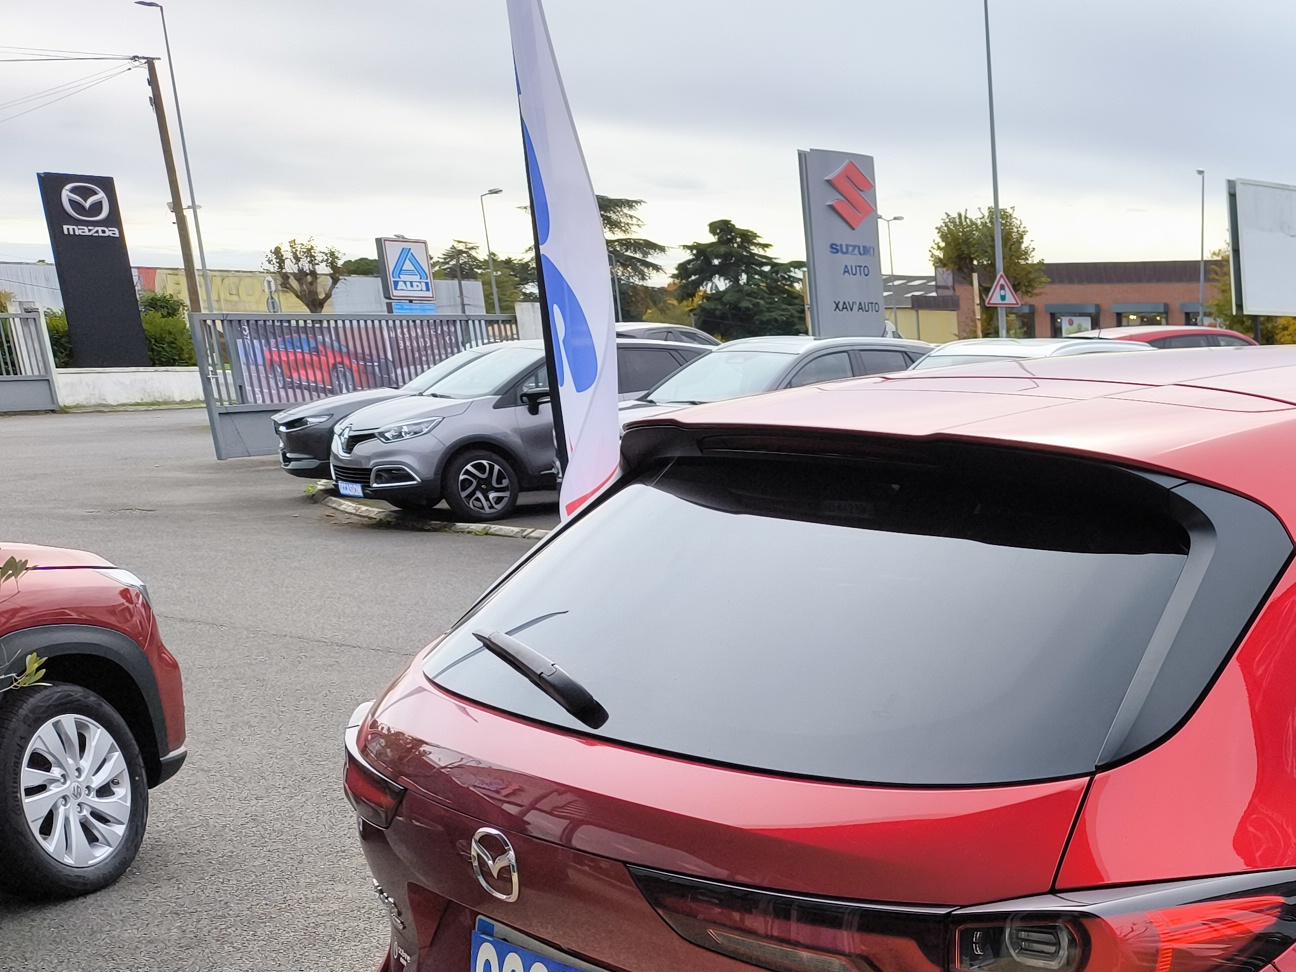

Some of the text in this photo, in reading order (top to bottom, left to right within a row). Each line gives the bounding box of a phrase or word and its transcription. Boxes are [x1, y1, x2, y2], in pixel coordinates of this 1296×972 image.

[62, 225, 119, 237] mazda
[829, 243, 875, 256] SUZUKI
[843, 265, 870, 277] AUTO
[397, 281, 427, 291] ALDI
[833, 301, 880, 312] XAV'AUTO
